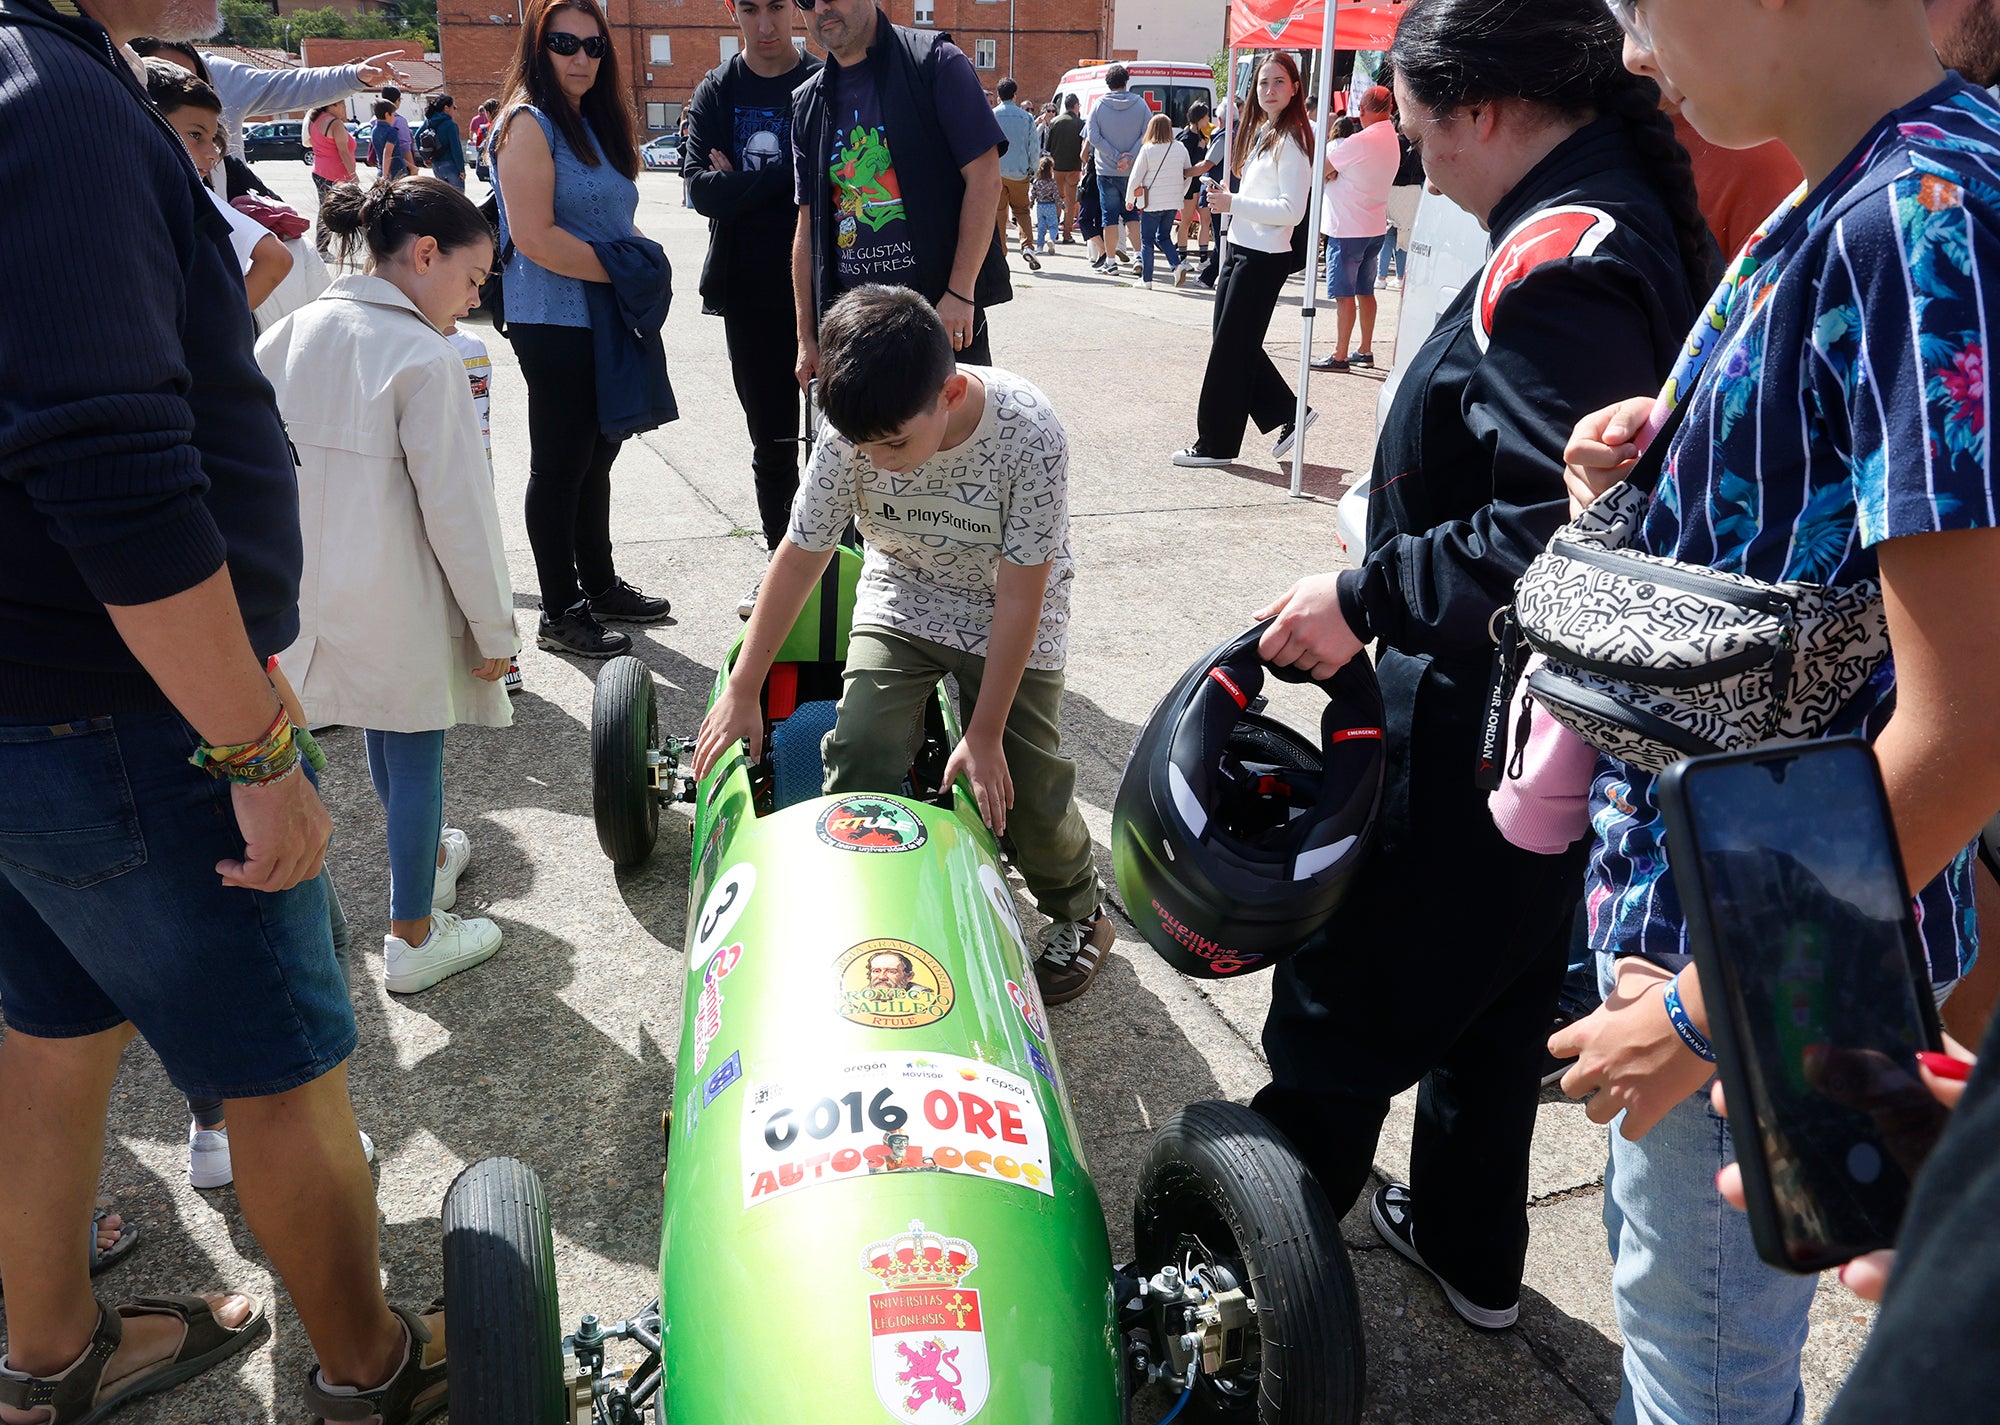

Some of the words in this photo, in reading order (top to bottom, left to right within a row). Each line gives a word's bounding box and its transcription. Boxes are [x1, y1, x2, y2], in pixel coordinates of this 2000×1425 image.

[856, 240, 911, 260] GUSTAN
[861, 263, 871, 274] Y
[907, 508, 992, 534] PlayStation
[504, 672, 521, 684] NIK
[1214, 671, 1240, 697] EMERGENCY
[1347, 729, 1378, 737] EMERGENCY
[1482, 709, 1500, 759] JORDAN
[830, 816, 915, 832] RTULE
[700, 881, 739, 944] 3
[1151, 899, 1219, 954] Miranda
[839, 1001, 944, 1017] GALILEO
[872, 1016, 918, 1026] RTULE
[986, 1075, 1026, 1097] repsol
[765, 1087, 908, 1151] 0016
[923, 1089, 1028, 1145] ORE
[751, 1144, 893, 1198] AUTOS
[906, 1145, 1047, 1187] LOCOS
[872, 1294, 943, 1310] VNIVERSITAS
[874, 1313, 946, 1330] LEGIONENSIS
